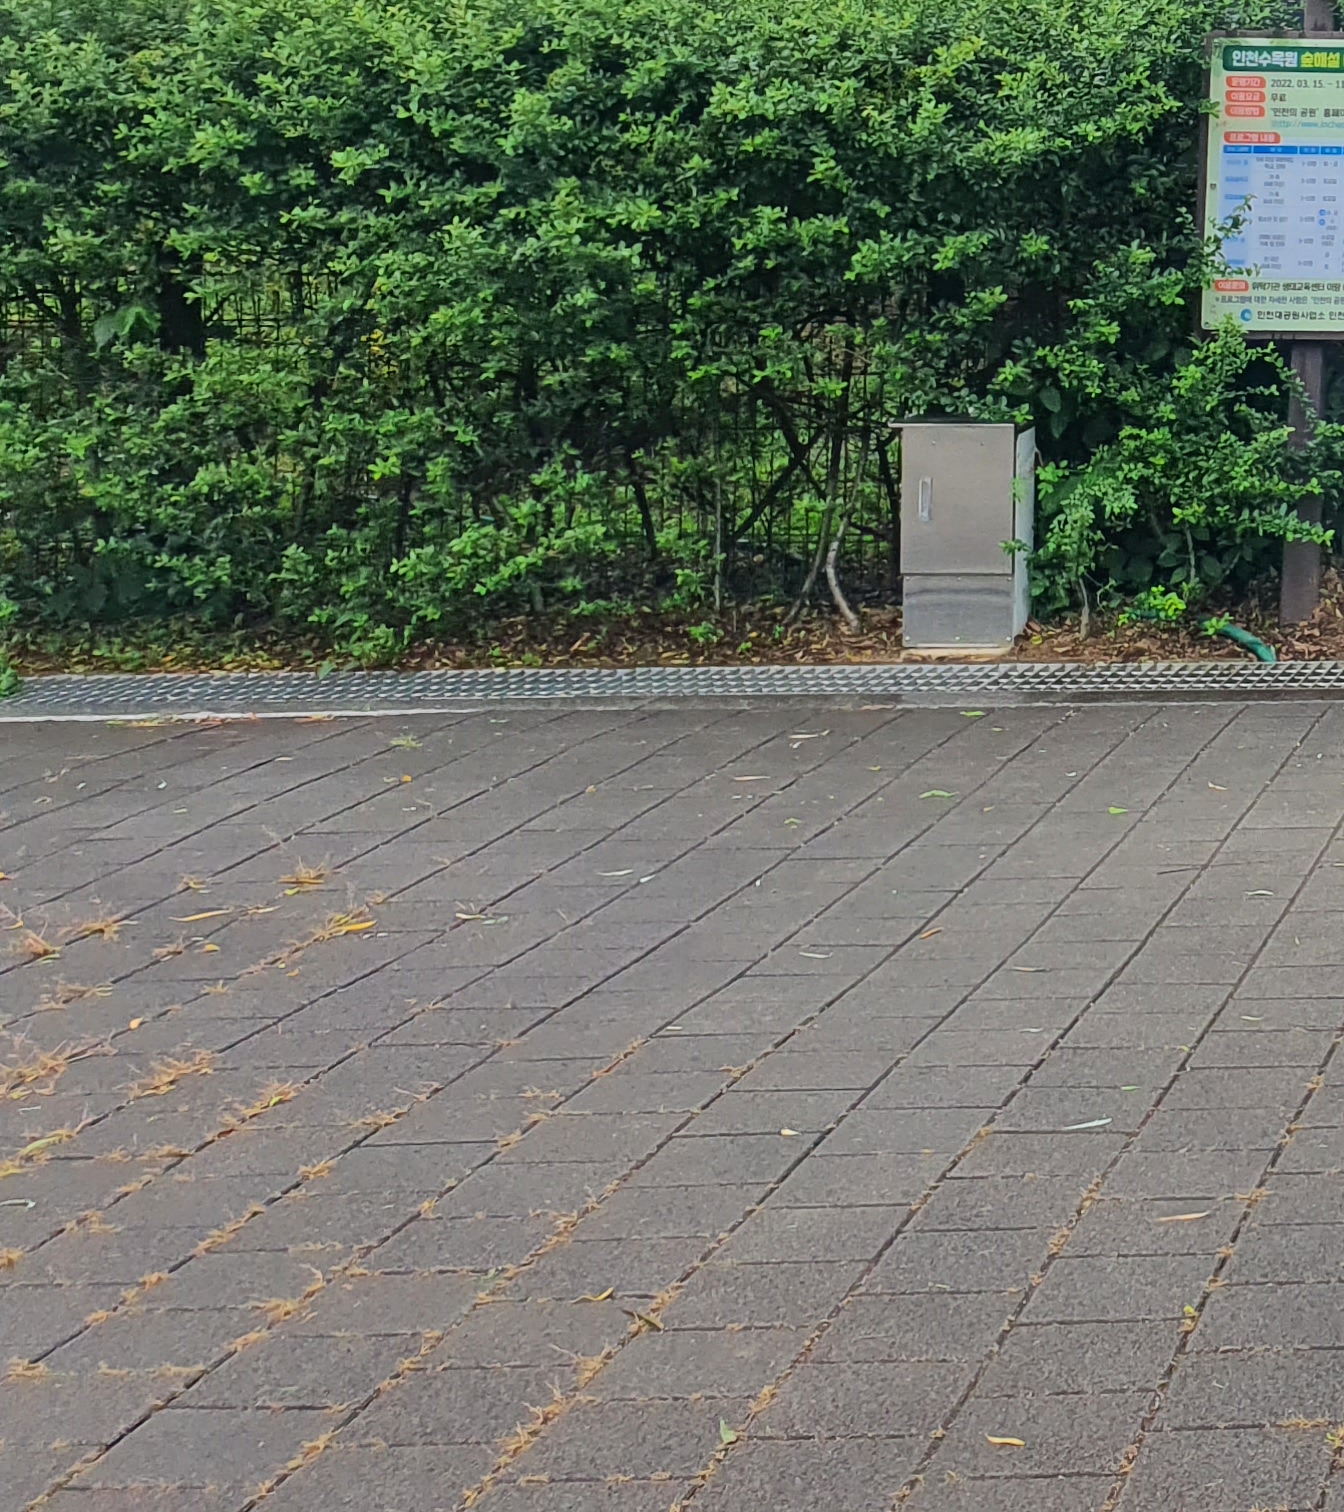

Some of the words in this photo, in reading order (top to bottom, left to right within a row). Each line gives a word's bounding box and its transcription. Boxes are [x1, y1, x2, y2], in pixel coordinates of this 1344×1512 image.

[1232, 50, 1297, 68] 인천수목원
[1271, 93, 1287, 102] 무료
[1257, 311, 1326, 320] 인천대공원사업소
